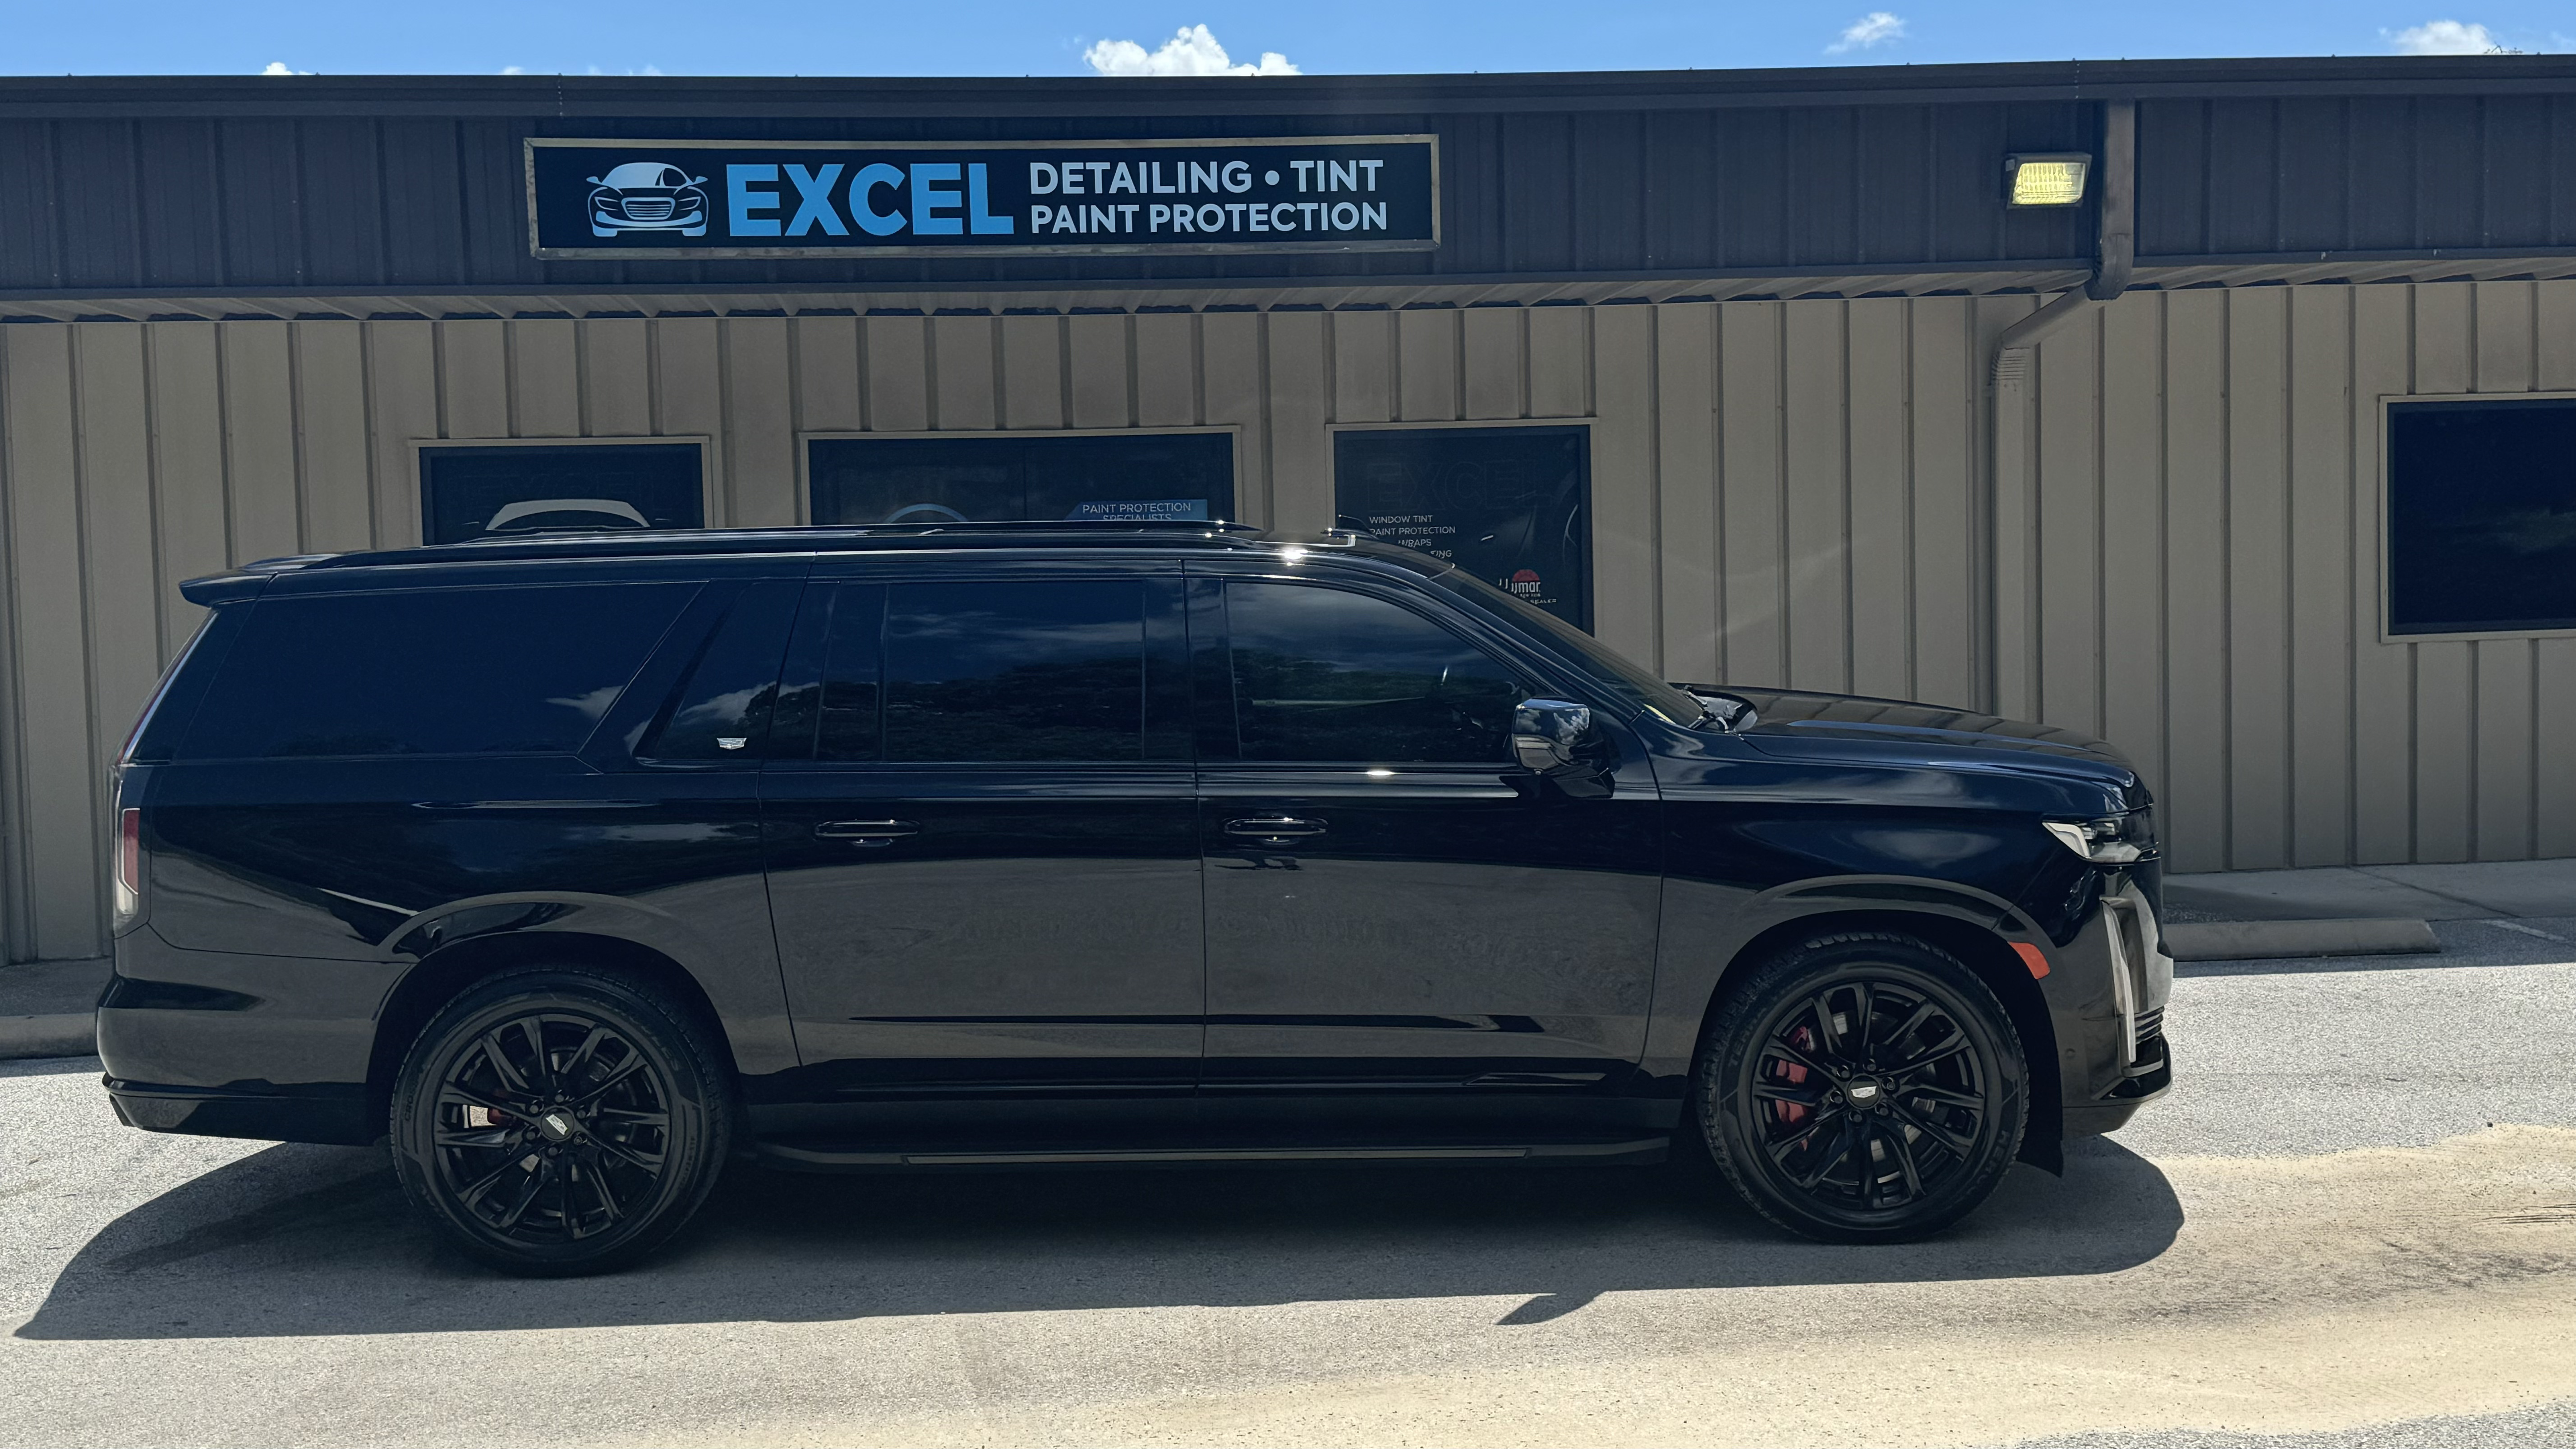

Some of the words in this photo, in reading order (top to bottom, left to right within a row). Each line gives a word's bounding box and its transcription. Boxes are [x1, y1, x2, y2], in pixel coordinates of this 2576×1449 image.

[1030, 161, 1252, 194] DETAILING
[1290, 160, 1383, 192] TINT
[726, 163, 1014, 237] EXCEL
[1031, 204, 1140, 234] PAINT
[1150, 202, 1387, 233] PROTECTION
[1083, 504, 1117, 513] PAINT
[1120, 502, 1191, 512] PROTECTION
[1399, 526, 1455, 535] PROTECTION
